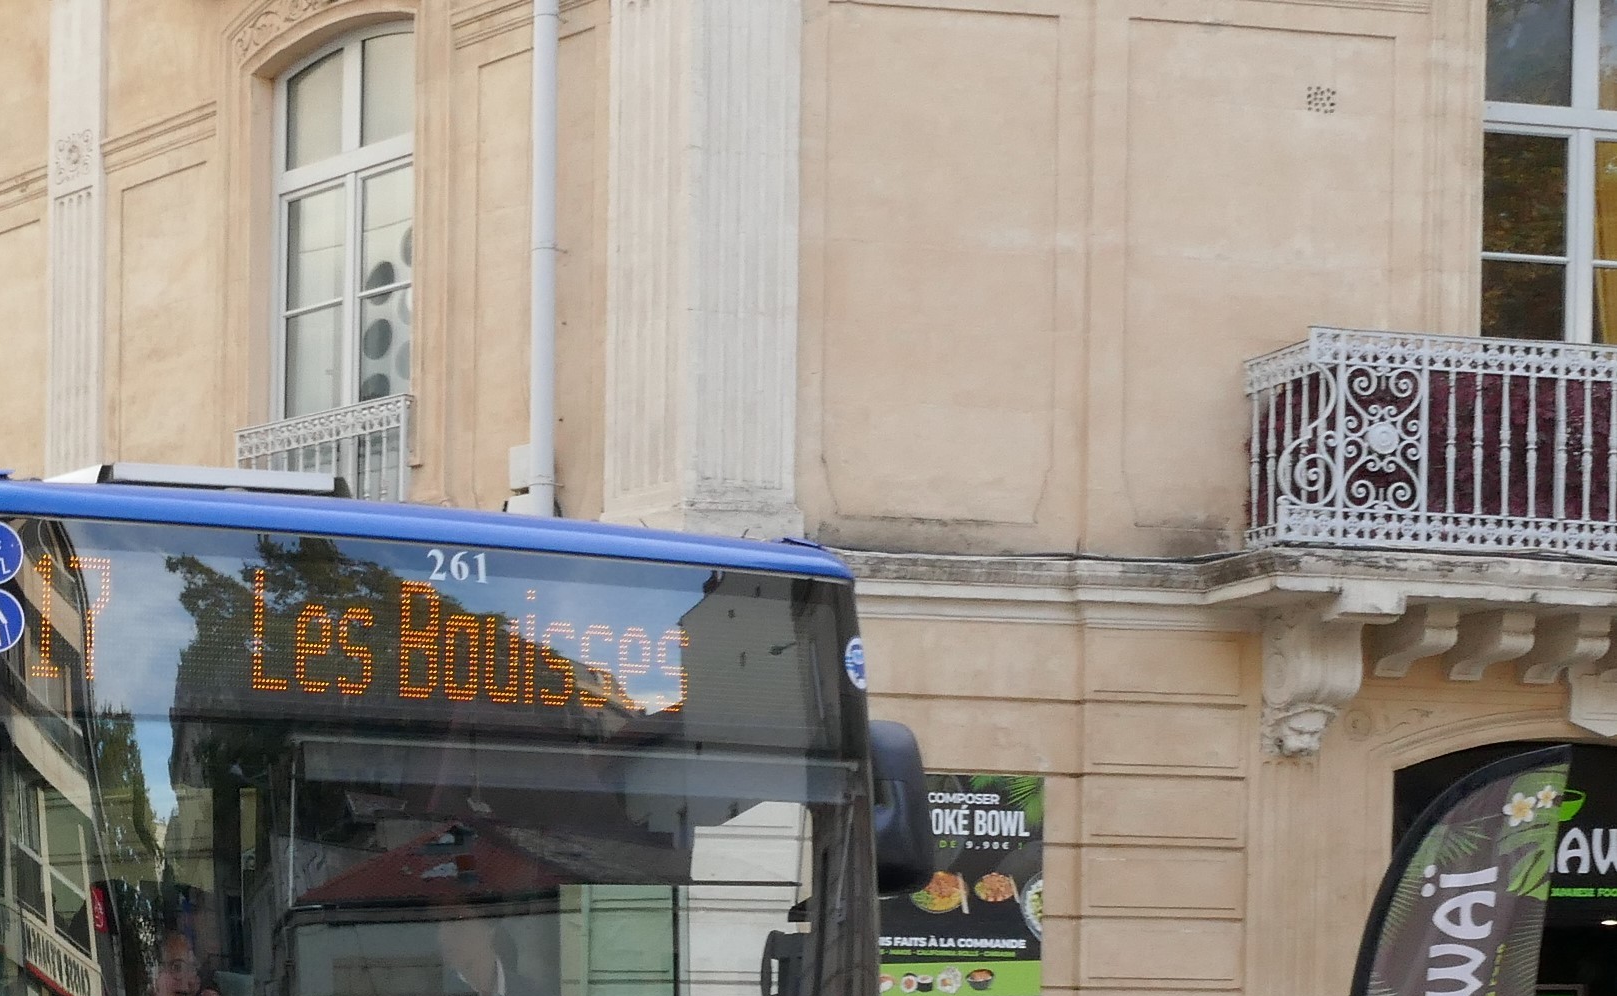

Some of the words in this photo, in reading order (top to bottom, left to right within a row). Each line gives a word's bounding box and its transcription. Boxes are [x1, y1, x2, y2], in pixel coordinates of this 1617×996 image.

[426, 548, 489, 585] 261
[31, 553, 111, 680] 17
[252, 568, 373, 695] Les
[399, 580, 689, 712] Bouisses
[927, 792, 1000, 805] COMPOSER
[929, 804, 971, 836] OKÉ
[973, 810, 1030, 837] BOWL
[938, 839, 958, 849] DE
[894, 937, 927, 947] FAITS
[928, 934, 939, 948] À
[939, 938, 956, 948] LA
[957, 938, 1026, 949] COMMANDE
